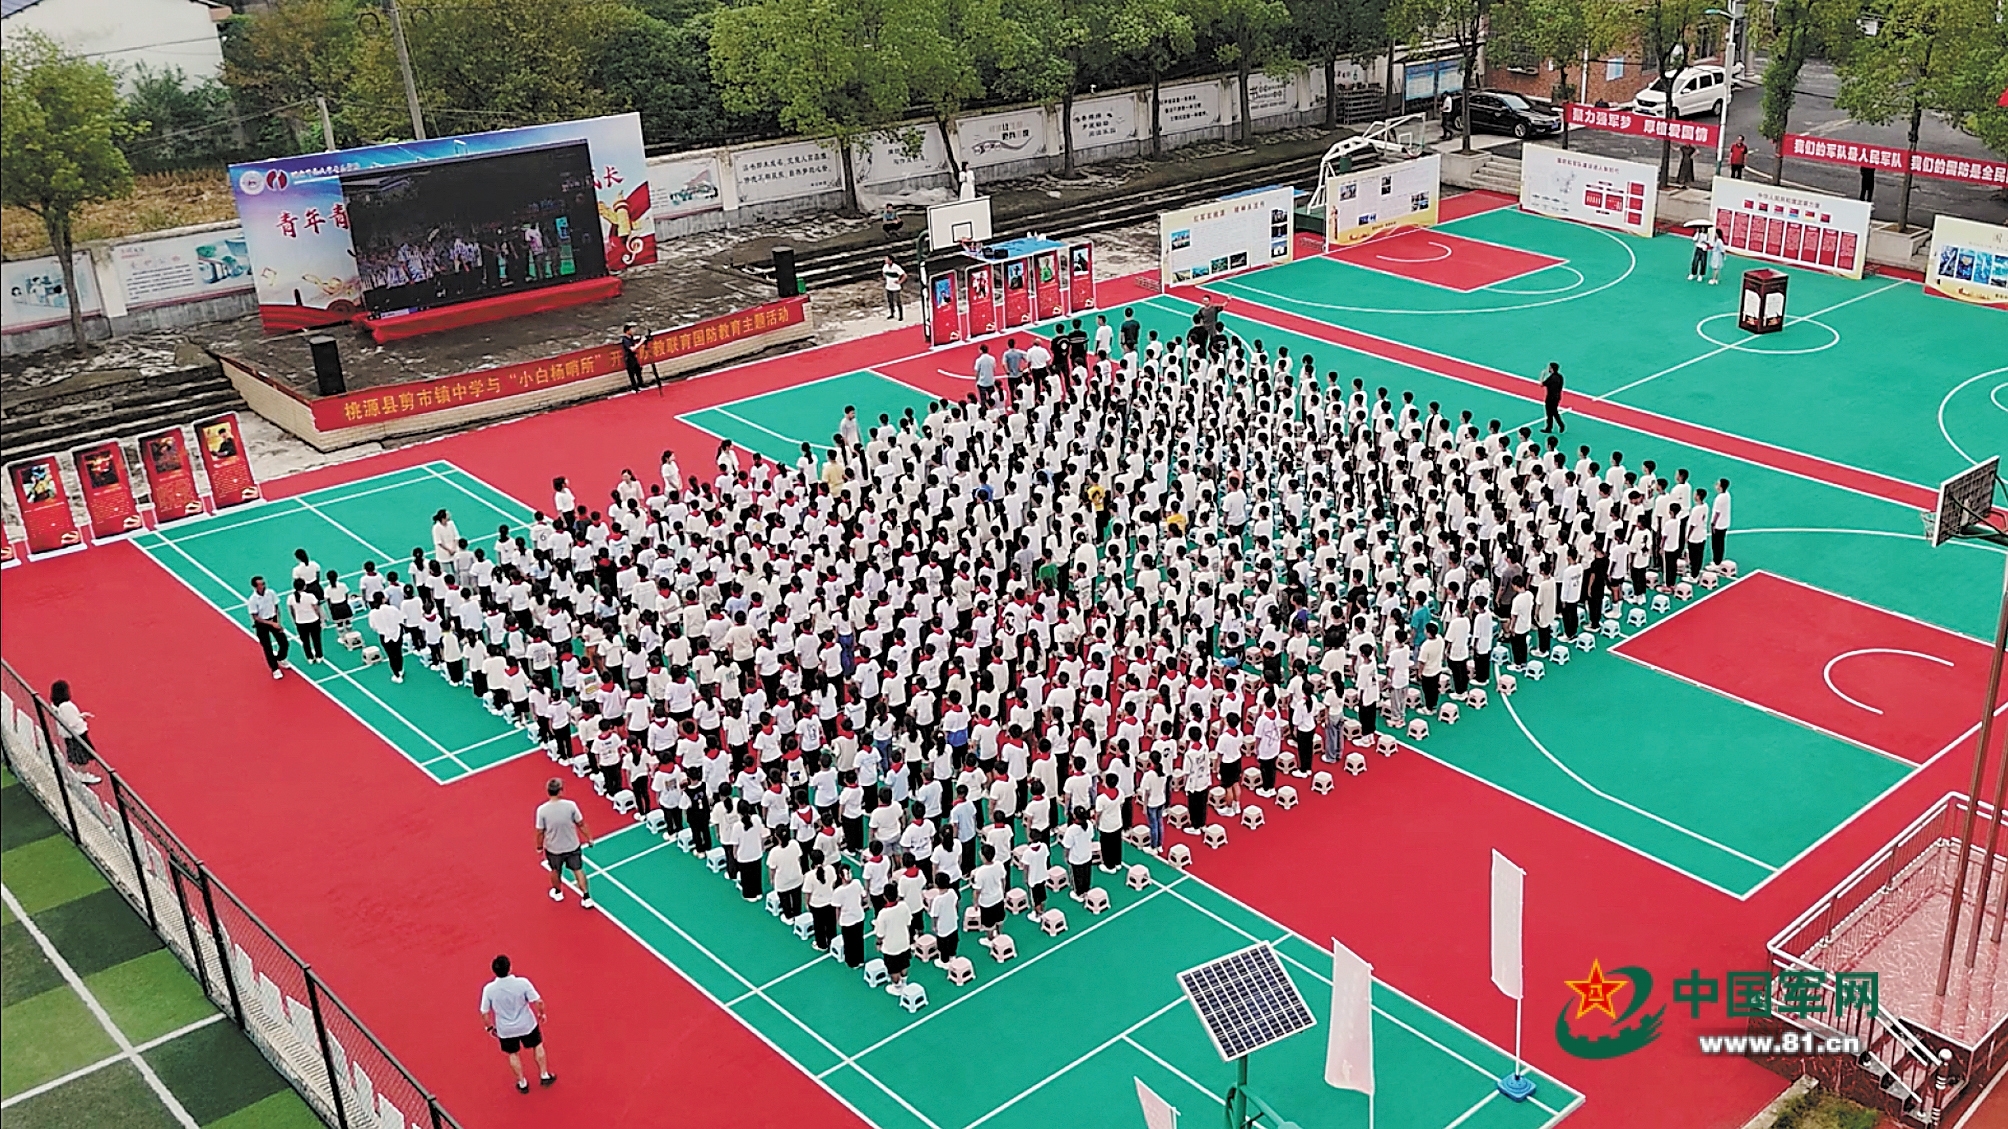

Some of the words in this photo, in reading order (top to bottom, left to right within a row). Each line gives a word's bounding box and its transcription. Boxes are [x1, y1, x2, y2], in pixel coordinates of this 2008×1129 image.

[1572, 107, 1632, 130] 聚力强军梦
[1794, 139, 1902, 168] 我们的军队是人民军队
[1910, 154, 2008, 184] 我们的国防是全民
[344, 307, 790, 422] 桃源县剪市镇中学与“小白杨哨所”开队教联育国防教育主题活动
